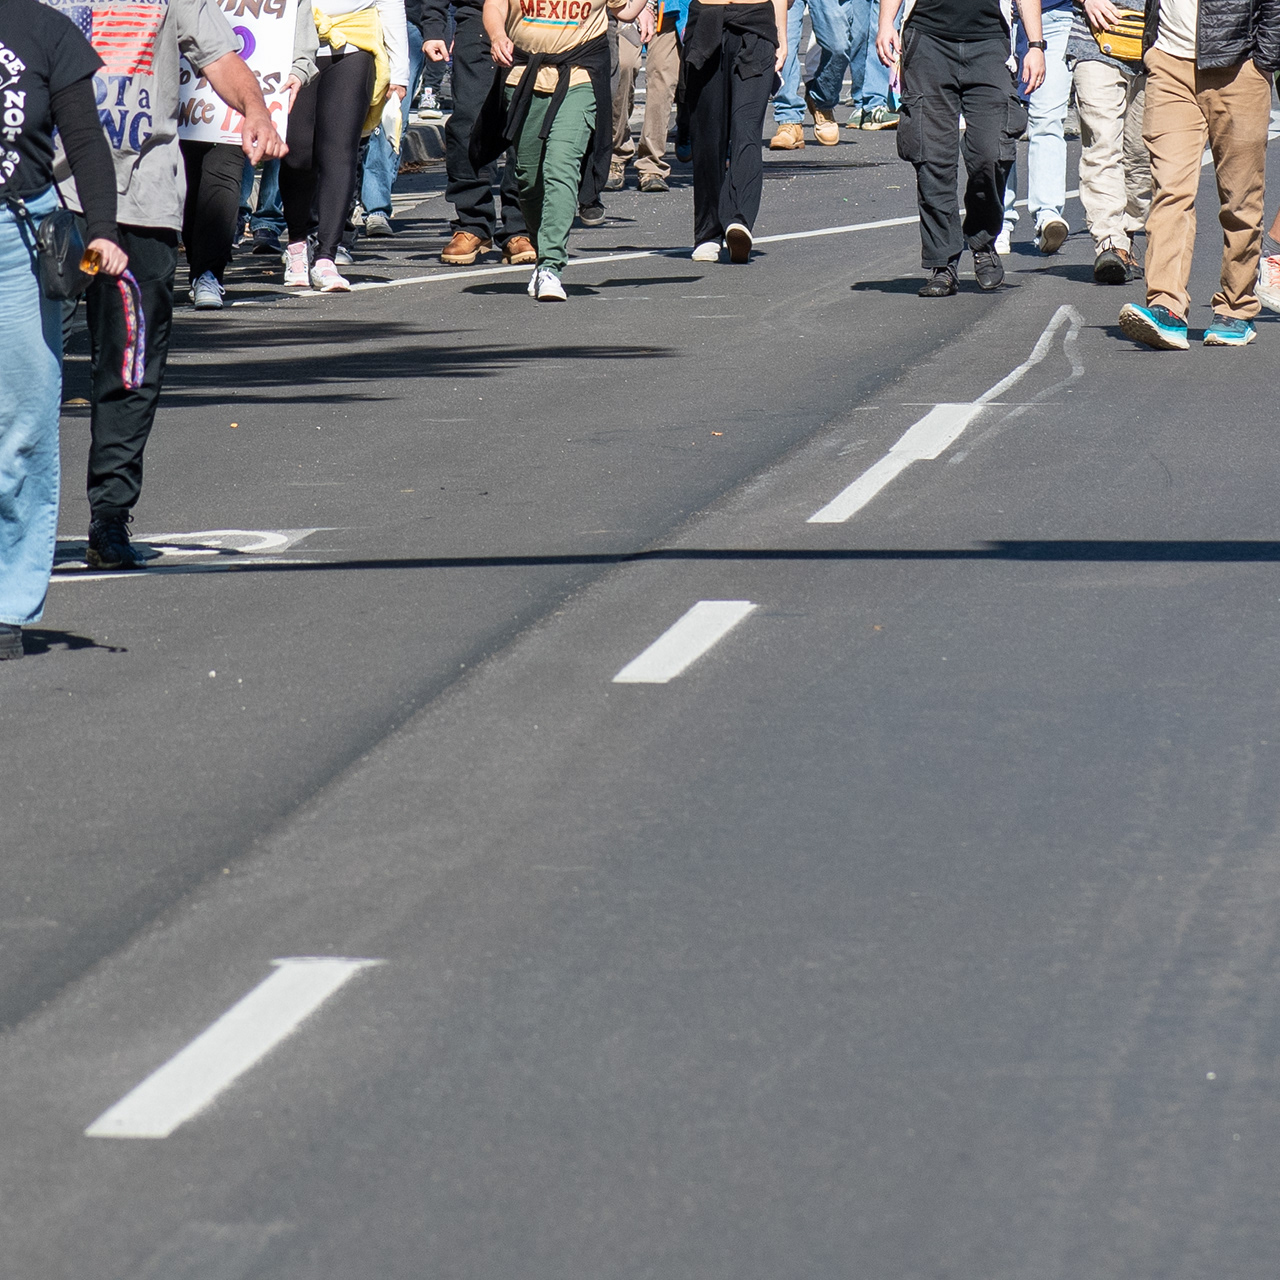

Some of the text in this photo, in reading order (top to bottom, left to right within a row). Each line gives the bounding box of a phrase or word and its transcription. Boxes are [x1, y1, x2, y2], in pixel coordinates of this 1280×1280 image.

[519, 0, 592, 20] MEXICO
[138, 88, 151, 109] a
[3, 90, 27, 142] NOT
